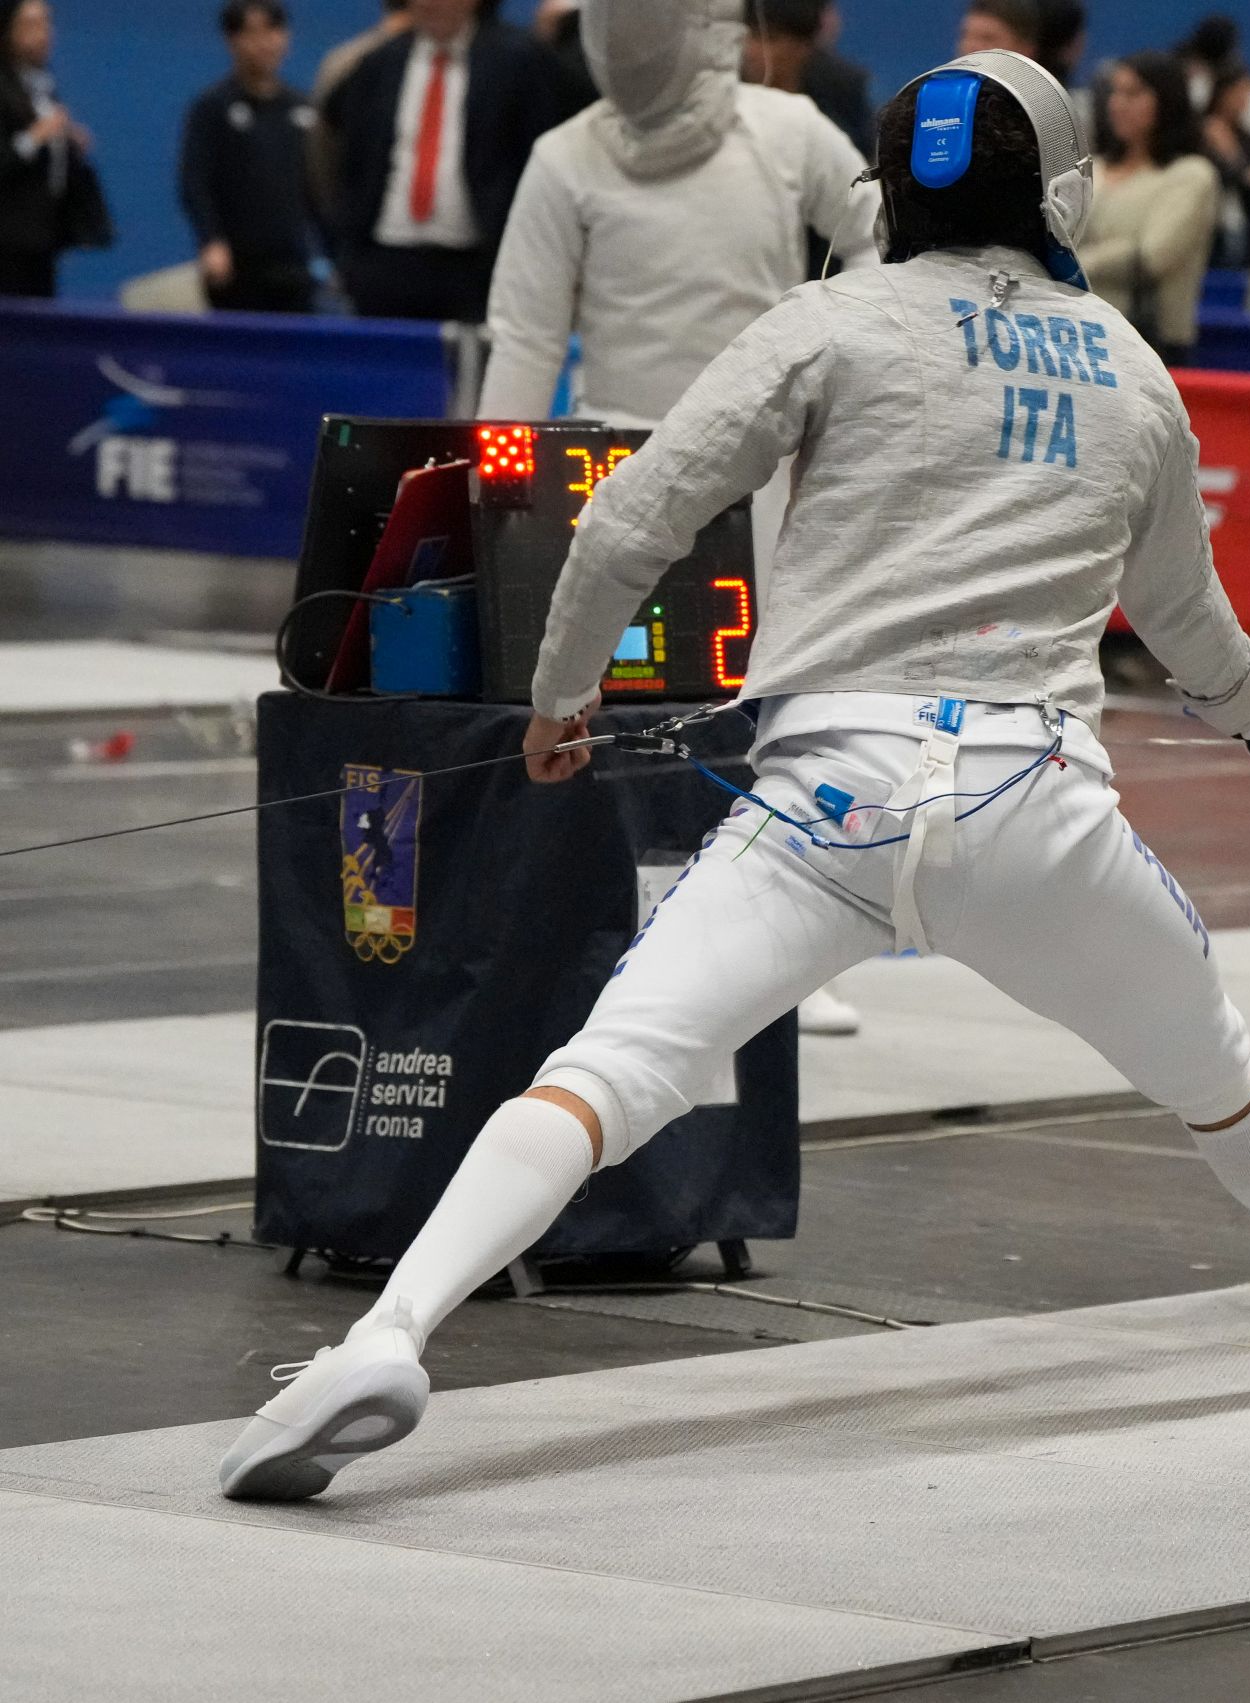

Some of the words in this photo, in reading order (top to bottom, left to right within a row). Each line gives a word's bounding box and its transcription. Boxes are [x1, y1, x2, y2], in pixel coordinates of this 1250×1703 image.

[921, 117, 960, 128] uhlmann
[949, 297, 1118, 389] TORRE
[997, 384, 1078, 469] ITA
[98, 436, 174, 503] FIE
[713, 578, 750, 688] 2
[918, 711, 937, 723] FIE
[347, 770, 382, 793] FIS
[375, 1046, 453, 1076] andrea
[370, 1078, 446, 1108] servizi
[365, 1115, 424, 1138] roma
